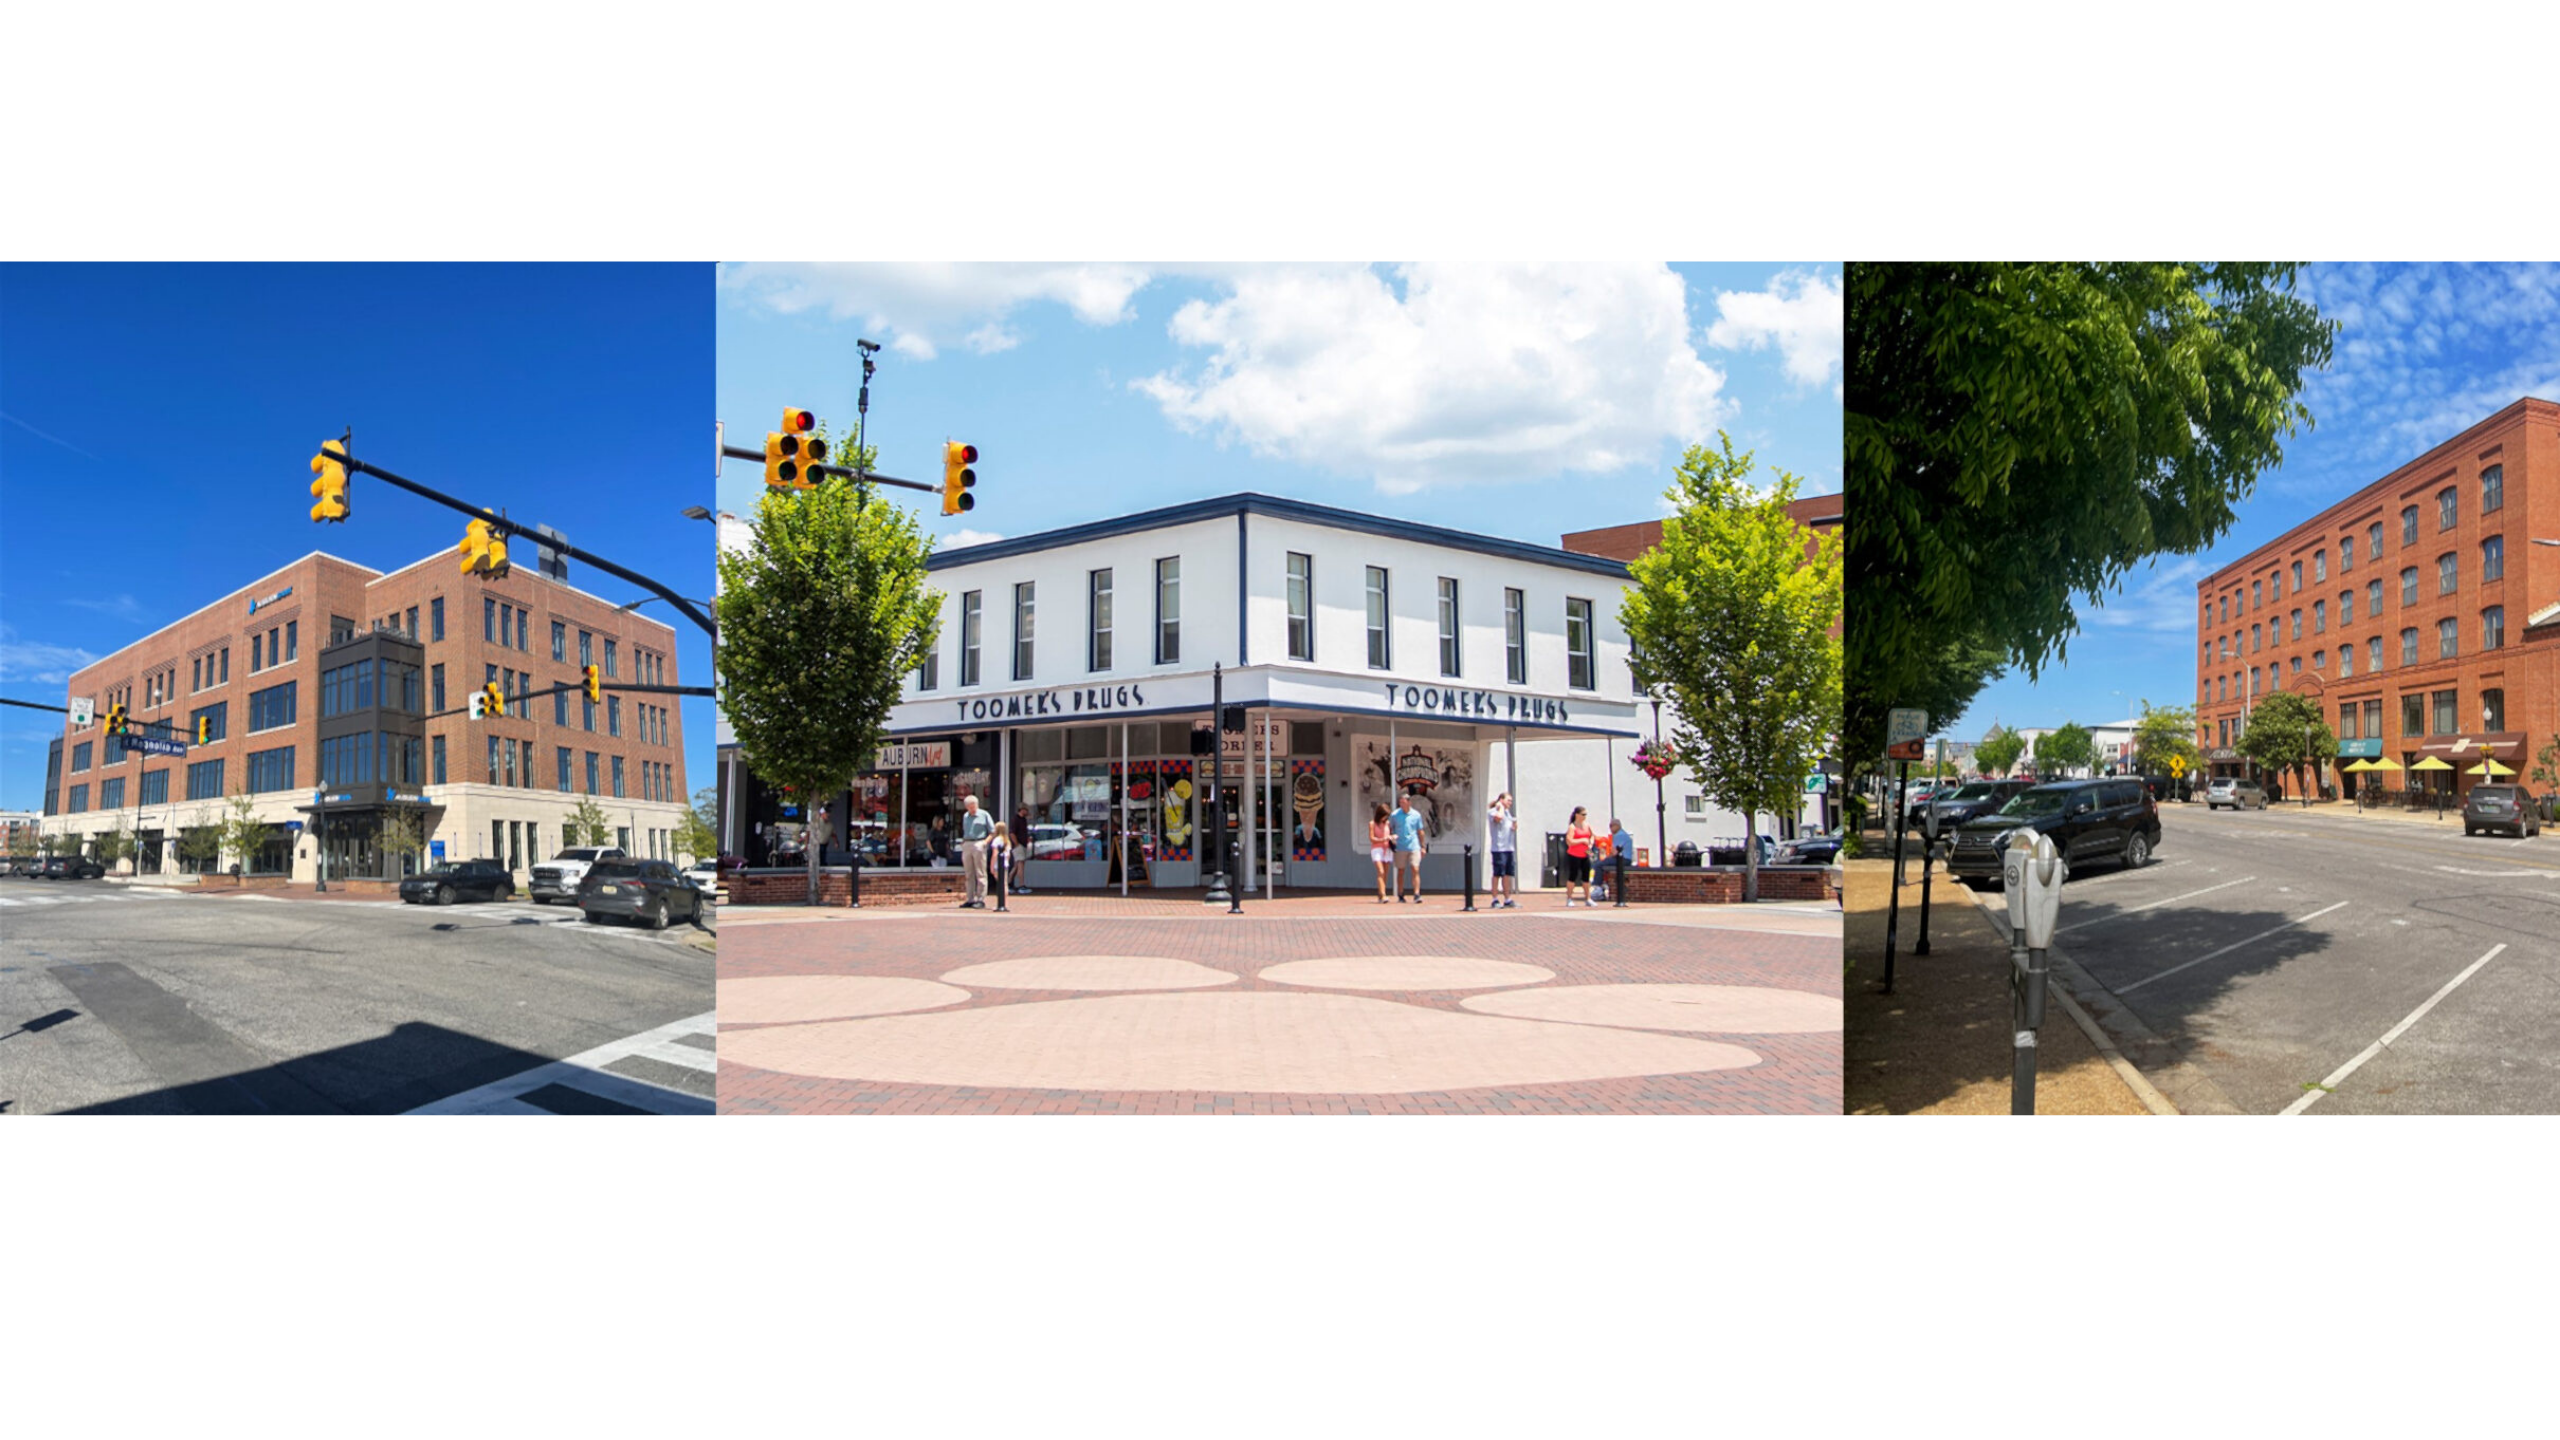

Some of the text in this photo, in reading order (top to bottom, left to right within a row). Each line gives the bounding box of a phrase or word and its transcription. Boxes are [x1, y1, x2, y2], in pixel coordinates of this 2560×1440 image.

[957, 684, 1144, 721] TOOMER'S DRUGS
[1385, 683, 1569, 722] TOOMER'S DRUGS
[882, 745, 928, 766] AUBURN
